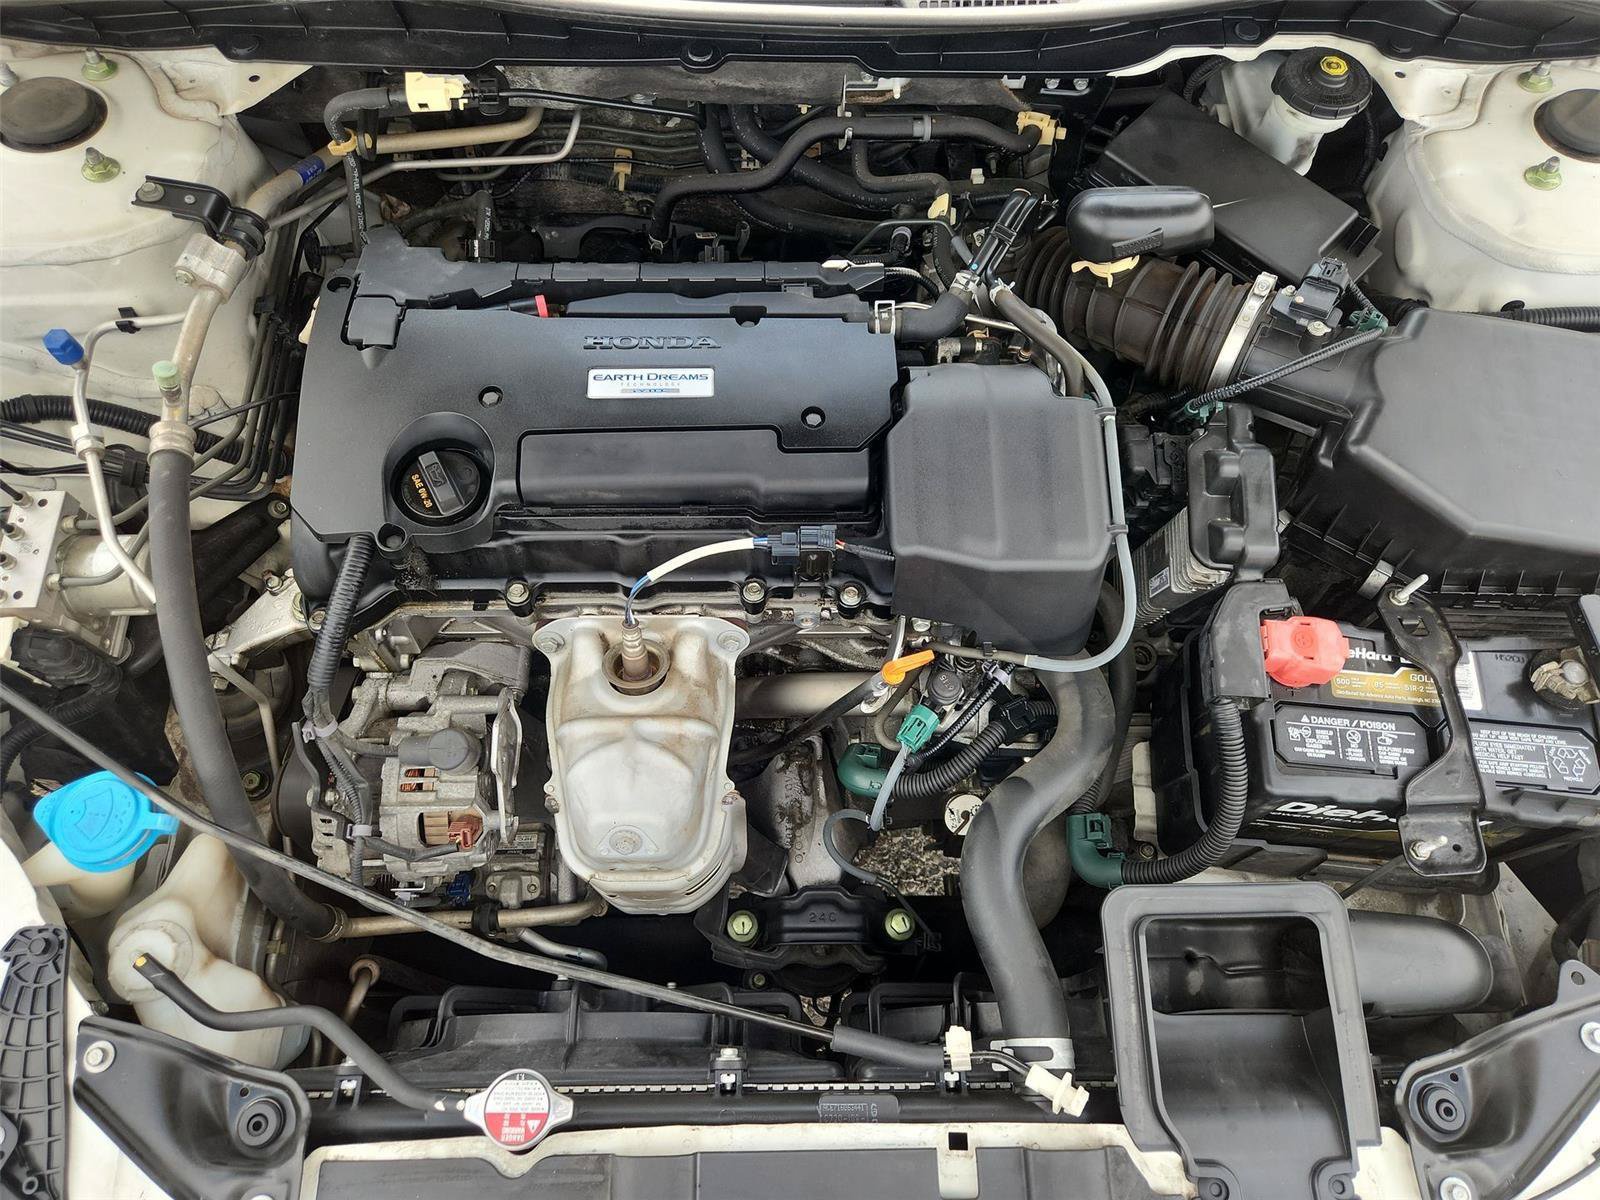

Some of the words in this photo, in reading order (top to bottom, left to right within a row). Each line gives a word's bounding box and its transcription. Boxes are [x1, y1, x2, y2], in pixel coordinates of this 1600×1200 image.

[583, 336, 721, 350] HONDA
[647, 373, 709, 381] DREAMS
[412, 473, 424, 489] SAE
[418, 488, 433, 508] 0W-20
[1311, 715, 1350, 727] DANGER
[1360, 720, 1396, 731] POISON
